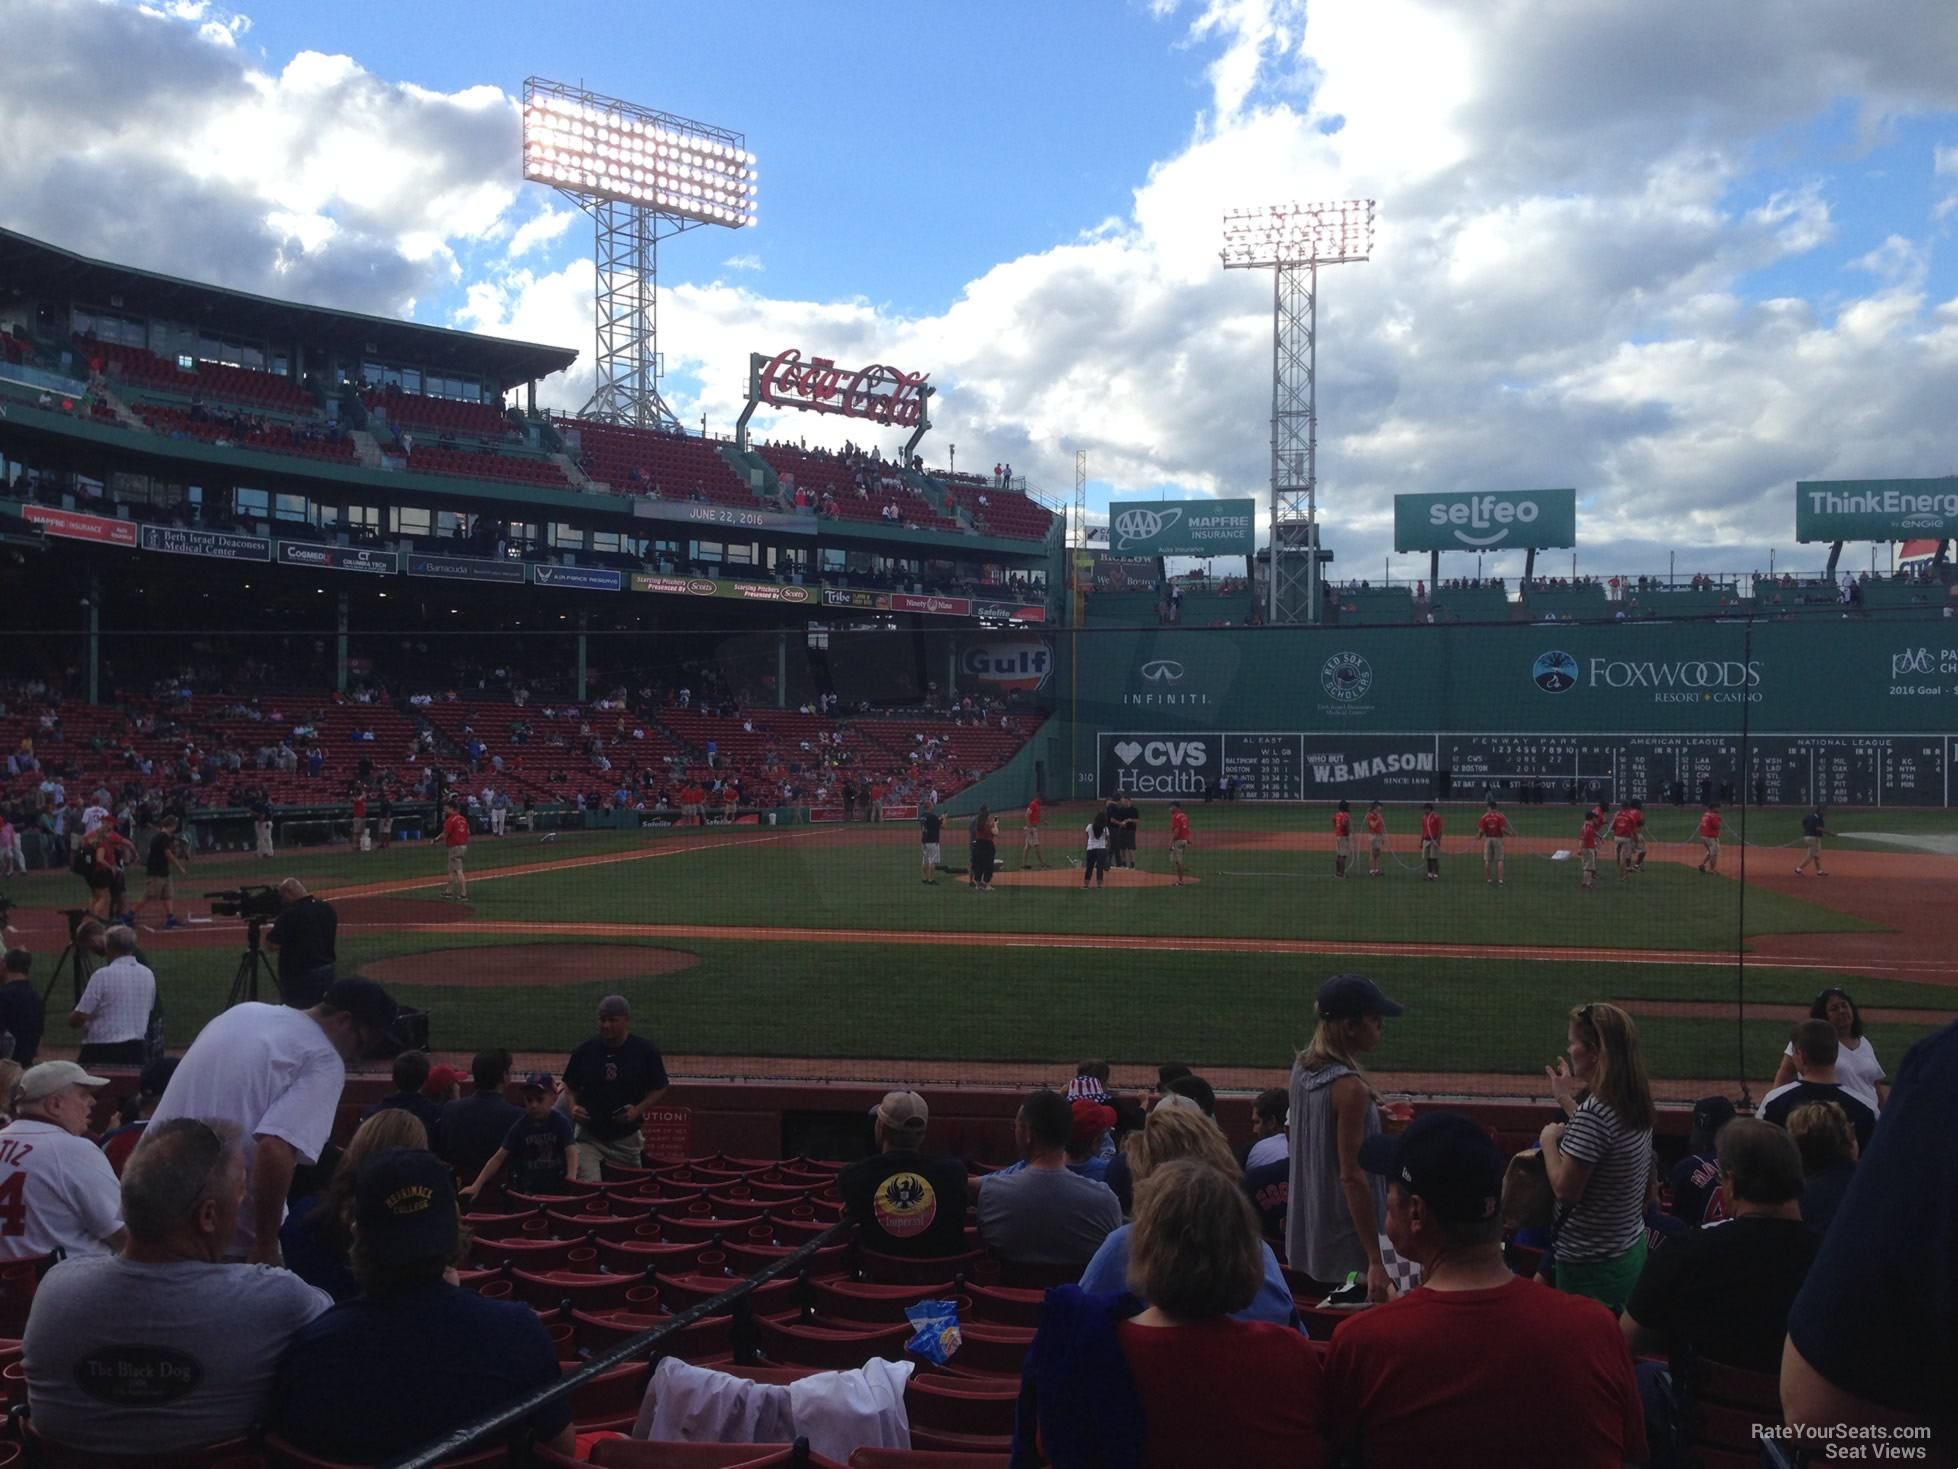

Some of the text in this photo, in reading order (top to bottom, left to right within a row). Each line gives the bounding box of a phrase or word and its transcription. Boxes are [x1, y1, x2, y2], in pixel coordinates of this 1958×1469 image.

[760, 348, 931, 428] Coca-Cola
[690, 508, 763, 527] JUNE 22, 2016
[1188, 516, 1249, 527] MAPFRE
[68, 522, 102, 533] INSURANCE
[1118, 511, 1157, 539] AAA
[164, 530, 265, 550] Beth Israel Deaconess
[1192, 530, 1245, 540] INSURANCE
[164, 540, 236, 556] Medical Center
[371, 560, 387, 568] TECH
[426, 563, 467, 574] Barracuda
[588, 577, 618, 585] RESERVE
[637, 576, 686, 587] Starting Pitchers
[648, 583, 686, 593] Presented By
[690, 581, 713, 592] Scotts
[734, 584, 780, 594] Starting Pitchers
[744, 591, 780, 600] Presented By
[784, 587, 805, 598] Scotts
[824, 590, 850, 604] Tribe
[906, 599, 953, 610] Ninety Nine
[977, 607, 1010, 618] Safelite
[965, 648, 1046, 675] Gulf
[1324, 654, 1363, 676] RED SOX
[1589, 658, 1762, 688] FOXWOODS
[1326, 671, 1370, 700] SCHOLARS
[1889, 685, 1941, 695] 2016 Goal
[1123, 694, 1207, 704] INFINITI
[1655, 692, 1763, 703] RESORT CASINO
[1472, 737, 1578, 745] FENWAY PARK
[1686, 738, 1726, 746] LEAGUE
[1144, 740, 1208, 767] CVS
[1261, 748, 1270, 756] W
[1225, 757, 1258, 765] BALTIMORE
[1307, 754, 1345, 763] WHO BUT
[1467, 755, 1484, 763] CWS
[1833, 757, 1847, 765] MIL
[1225, 766, 1251, 774] BOSTON
[1461, 764, 1489, 772] BOSTON
[1765, 764, 1781, 772] LAD
[1832, 765, 1848, 773] OAK
[1078, 773, 1094, 783] 310
[1116, 769, 1207, 793] Health
[1383, 777, 1430, 785] SINCE 1898
[1246, 791, 1258, 799] BAY
[642, 820, 672, 828] Safelite
[642, 1112, 688, 1121] UTION!
[886, 1215, 925, 1233] Imperial
[87, 1360, 192, 1384] The Black Dog
